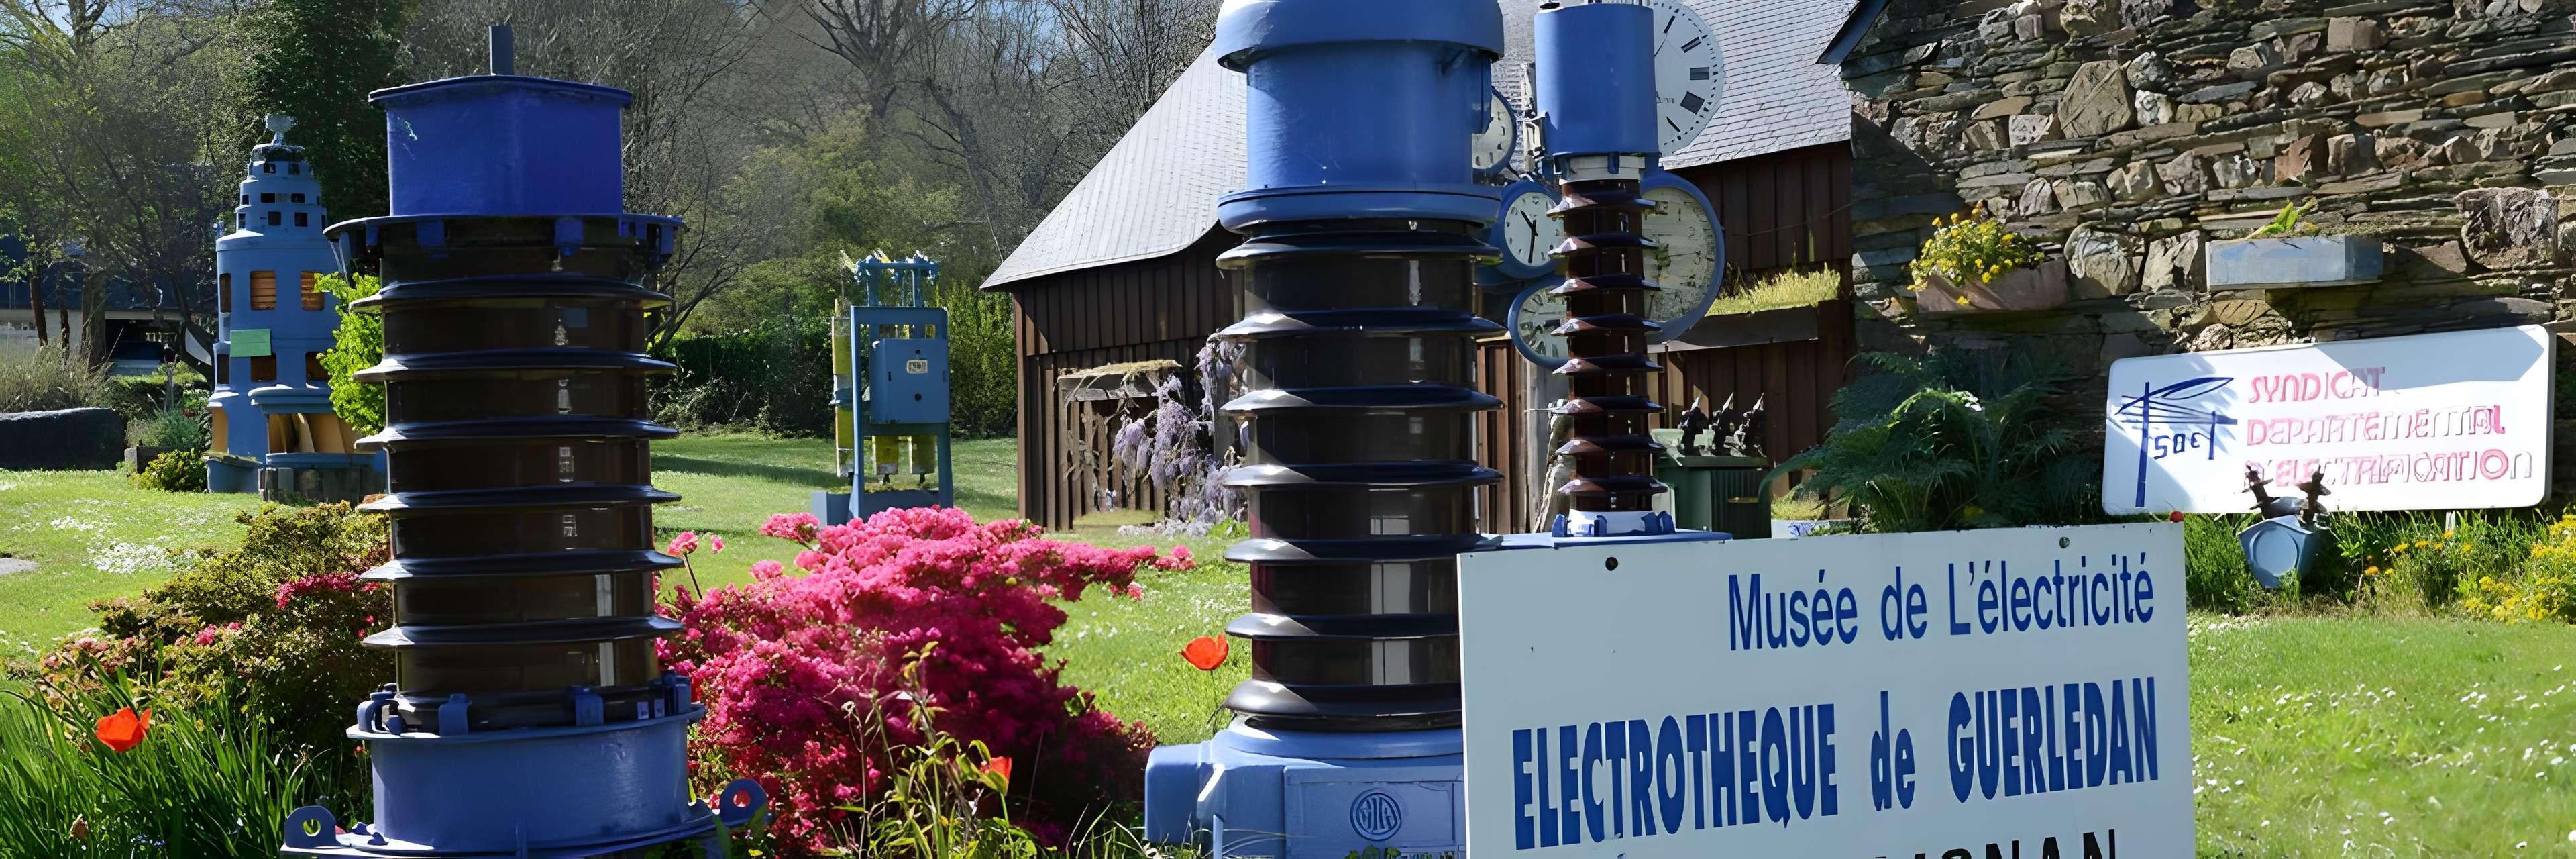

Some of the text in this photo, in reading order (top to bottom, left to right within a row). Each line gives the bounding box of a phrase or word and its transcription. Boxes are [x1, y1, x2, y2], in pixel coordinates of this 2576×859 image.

[2248, 366, 2386, 404] SYNDICAT
[2246, 404, 2506, 446] DEPARTEMENTAL
[1728, 552, 2154, 651] Musée de L'électricité
[1512, 676, 2159, 850] ELECTROTHEQUE de GUERLEDAN
